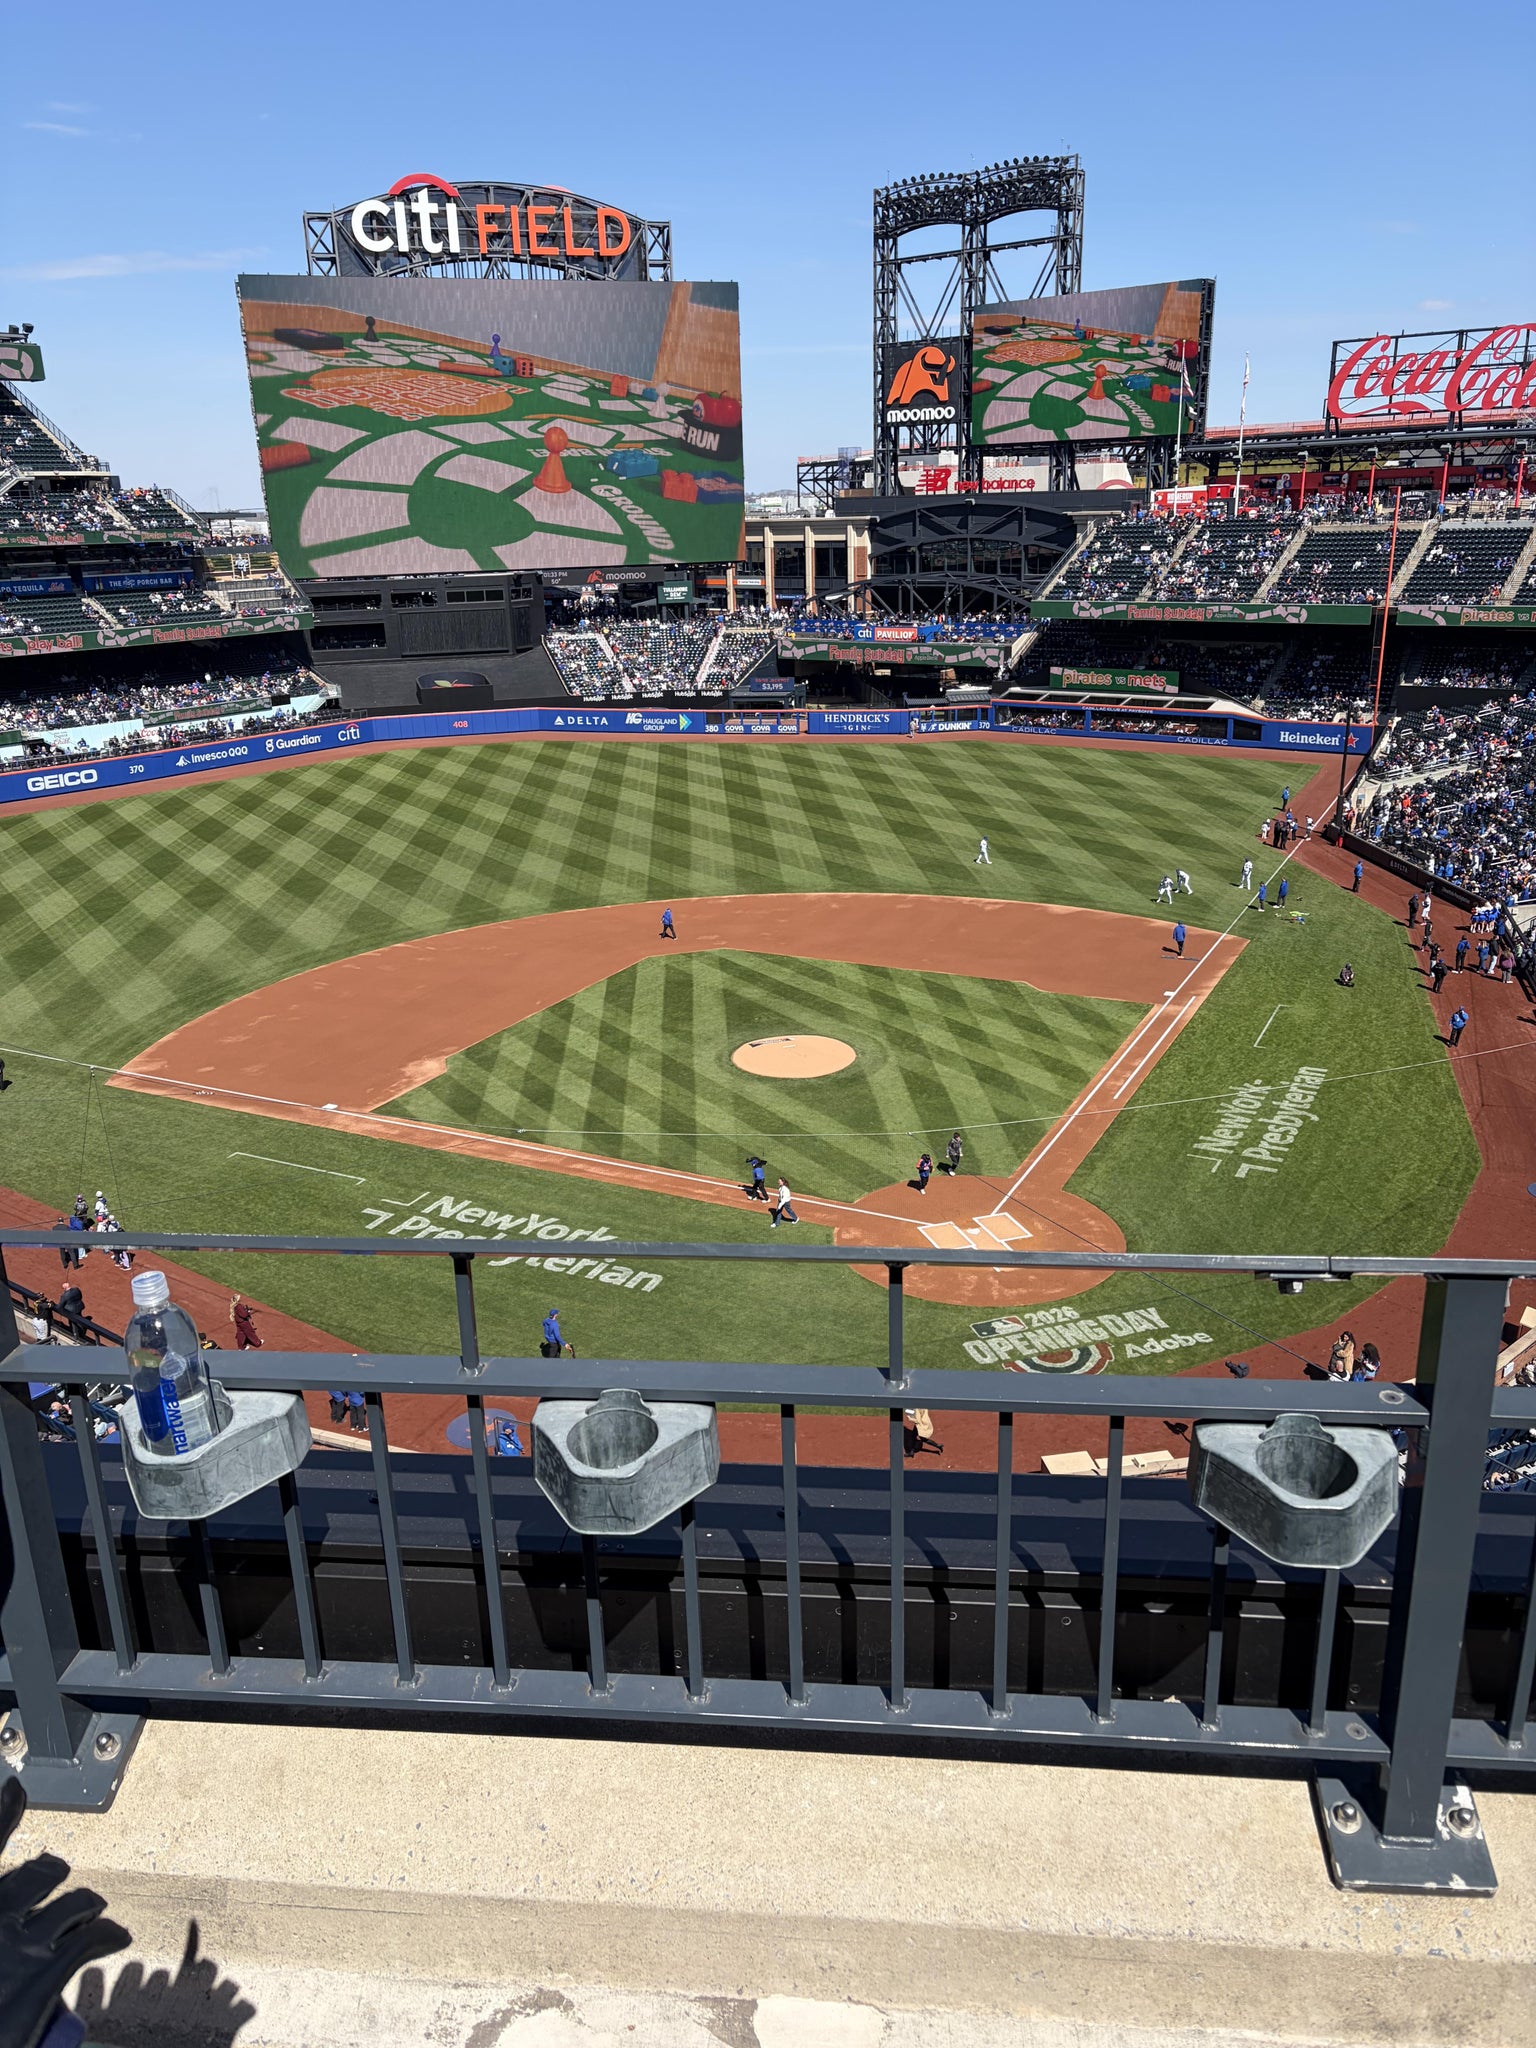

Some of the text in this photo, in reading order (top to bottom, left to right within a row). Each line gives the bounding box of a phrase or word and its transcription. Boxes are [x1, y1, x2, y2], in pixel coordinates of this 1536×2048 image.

[350, 185, 632, 257] citi FIELD
[886, 406, 956, 423] moomoo
[686, 427, 720, 451] RUN
[954, 480, 979, 490] new
[982, 476, 1036, 490] balance
[590, 484, 675, 550] GROUND
[606, 572, 646, 580] moomoo
[1128, 604, 1162, 620] Family
[1164, 606, 1205, 622] Sunday
[1460, 608, 1514, 626] pirates
[152, 624, 222, 644] Family Sunday
[858, 629, 914, 639] citi PAVILION
[27, 636, 53, 653] play
[56, 635, 83, 649] ball!
[829, 645, 863, 664] Family
[864, 646, 904, 664] Sunday
[1062, 669, 1167, 688] pirates vs mets
[452, 720, 468, 728] 408
[567, 716, 608, 726] DELTA
[824, 714, 890, 723] HENDRICK'S
[938, 722, 972, 730] DUNKIN'
[338, 726, 360, 742] citi
[643, 724, 664, 732] GROUP
[1012, 726, 1056, 735] CADILLAC
[276, 734, 321, 750] Guardian
[1177, 736, 1228, 746] CADILLAC
[1280, 731, 1340, 746] Heineken
[191, 746, 248, 764] Invesco QQQ
[128, 764, 144, 774] 370
[26, 769, 98, 792] GEICO
[1240, 1066, 1328, 1163] Presbyterian
[1024, 1306, 1080, 1328] 2026
[962, 1307, 1170, 1365] OPENING DAY
[1124, 1332, 1214, 1359] Adobe
